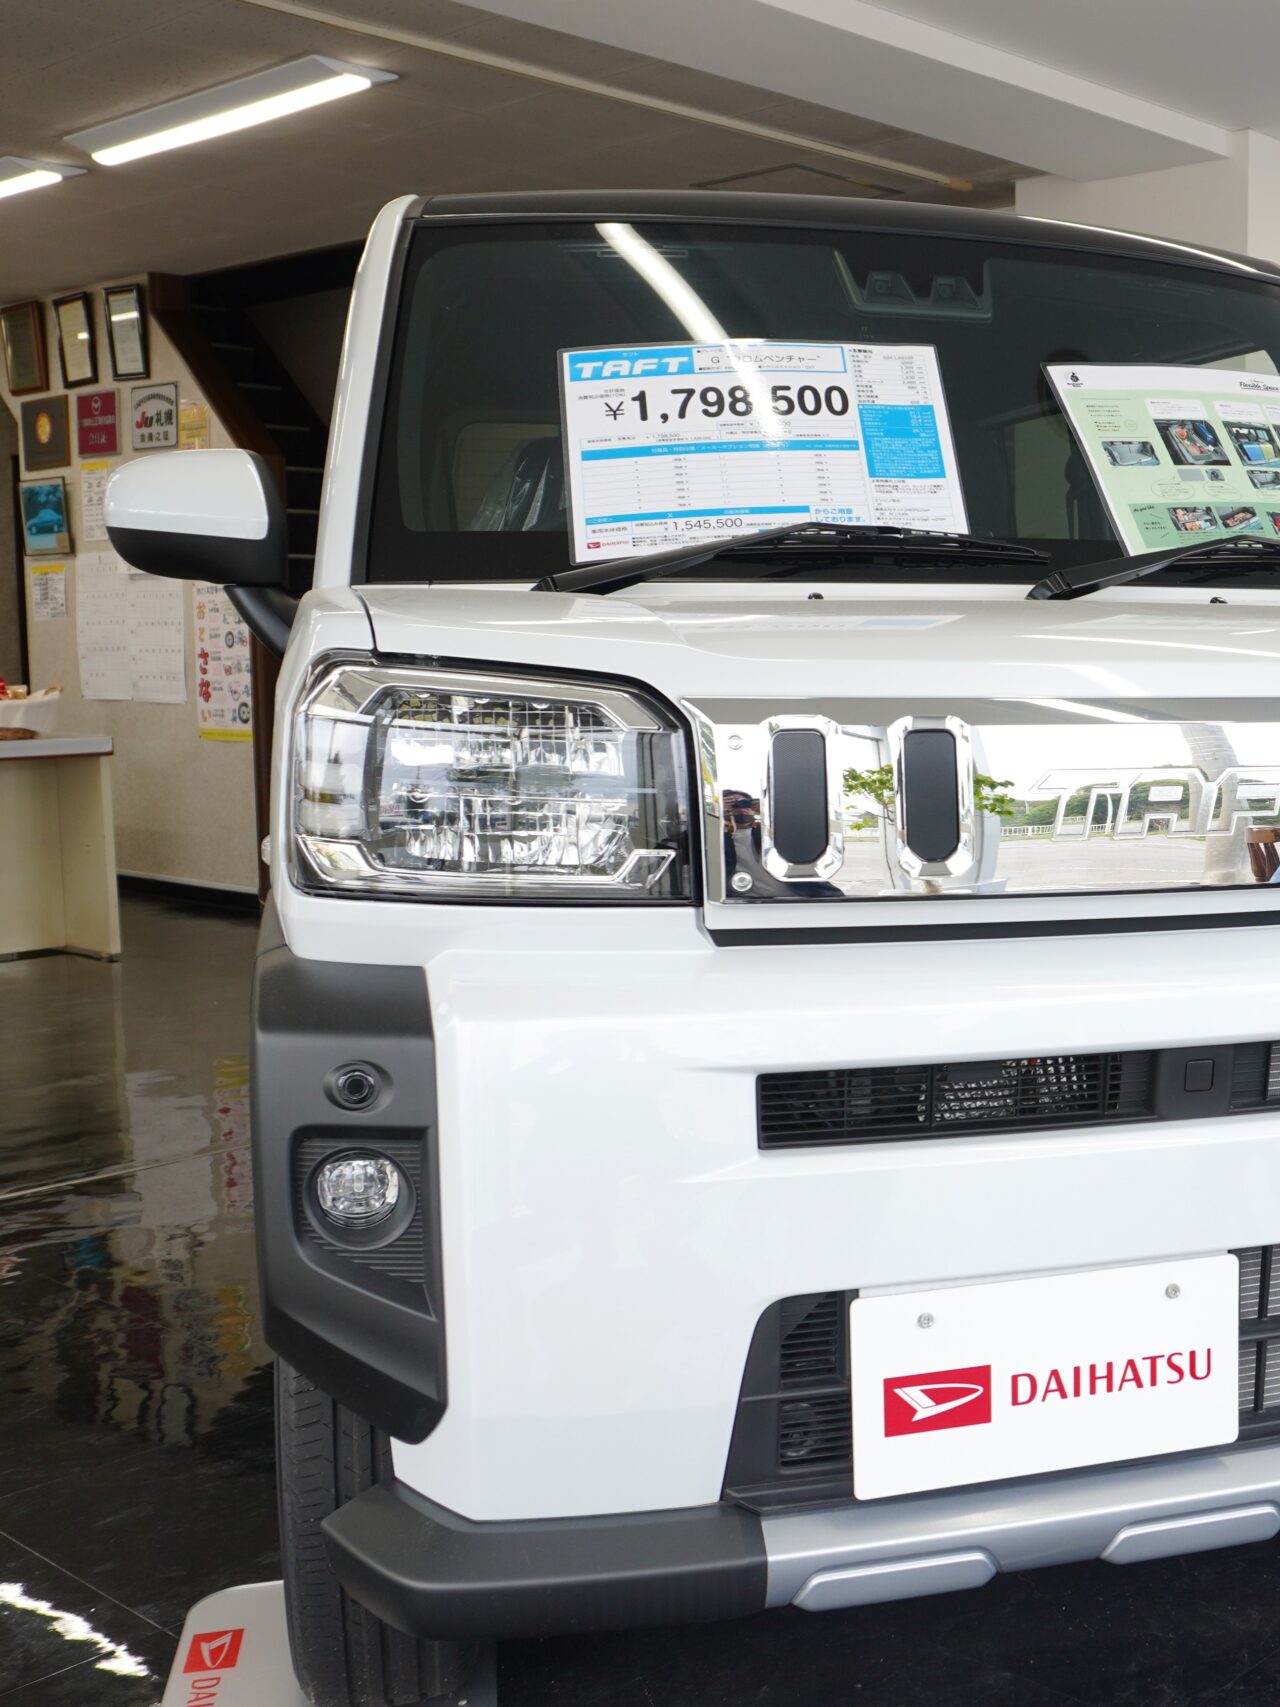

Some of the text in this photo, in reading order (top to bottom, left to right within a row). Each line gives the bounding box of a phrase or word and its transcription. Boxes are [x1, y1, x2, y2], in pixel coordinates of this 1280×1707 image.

[574, 356, 689, 379] TAFT
[711, 356, 720, 364] G
[672, 517, 743, 531] 1,545,500
[1010, 1347, 1212, 1407] DAIHATSU
